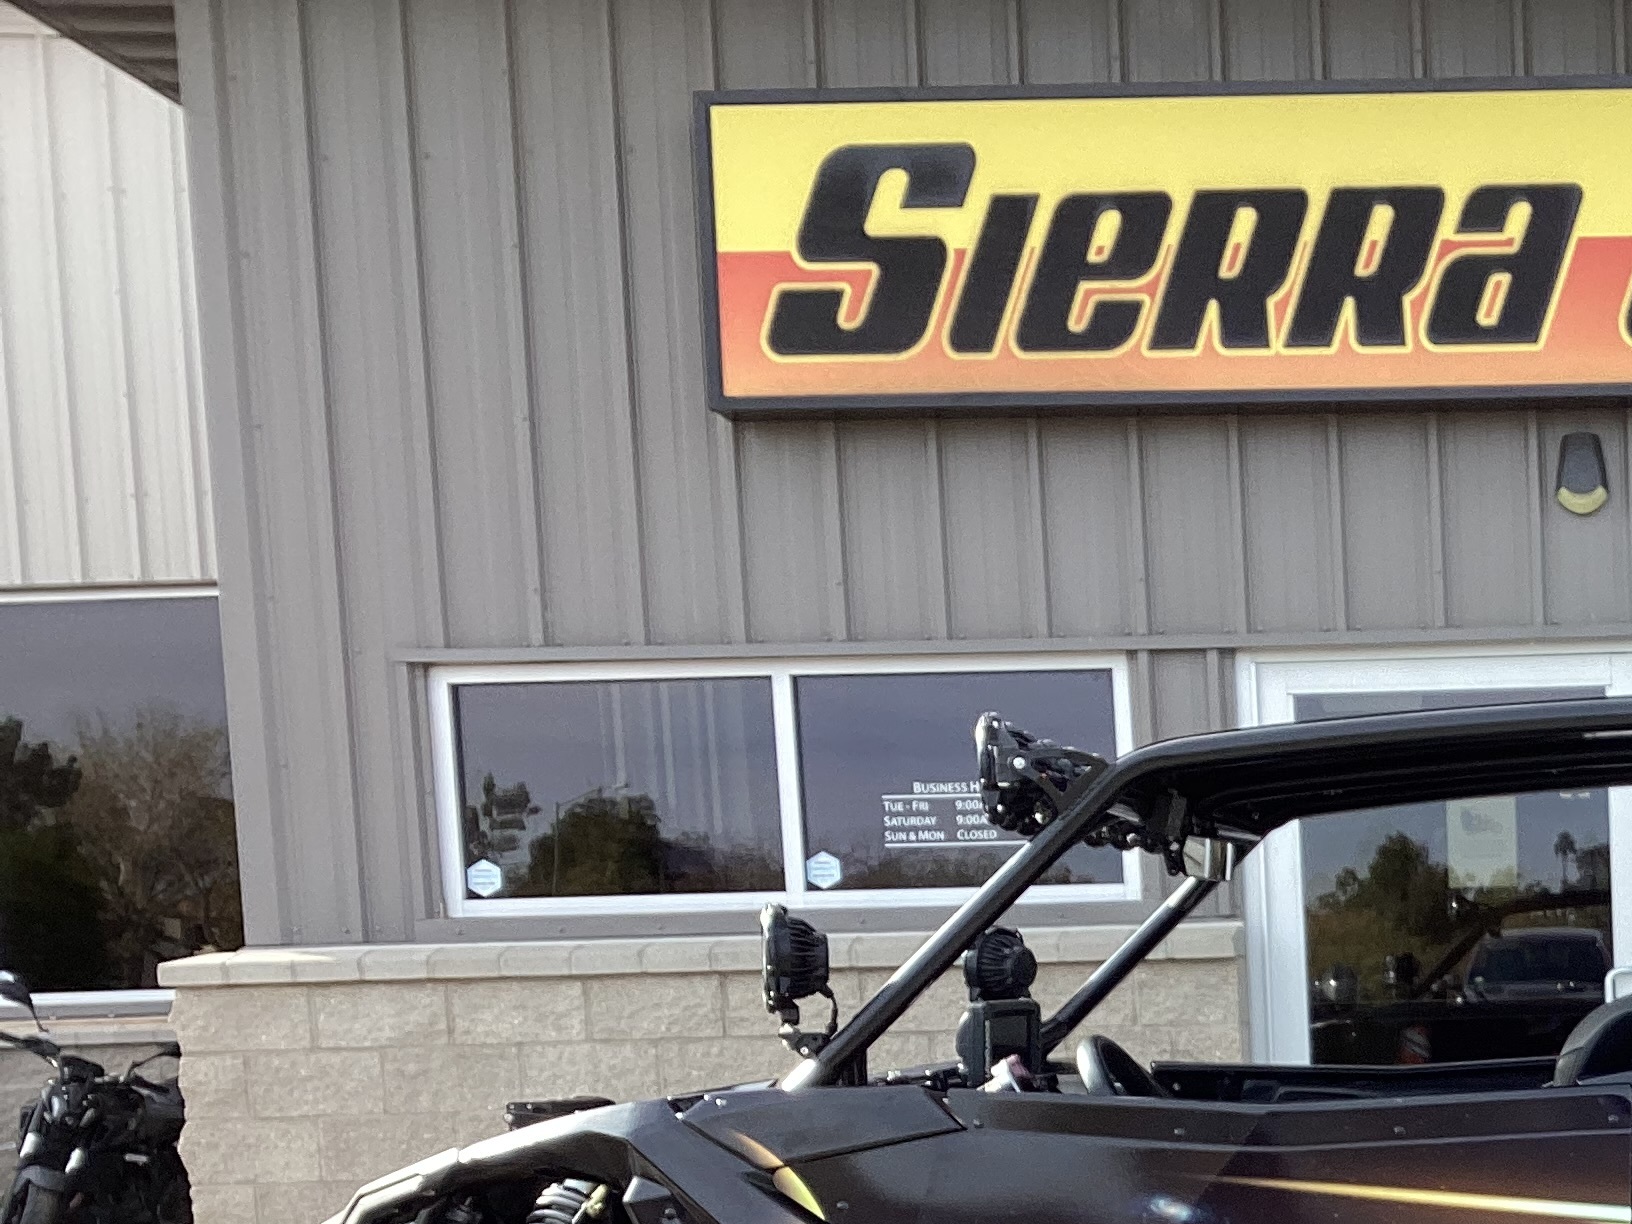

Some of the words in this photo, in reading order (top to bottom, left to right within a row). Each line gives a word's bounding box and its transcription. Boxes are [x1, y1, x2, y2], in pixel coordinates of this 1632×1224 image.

[884, 801, 903, 812] TUE
[955, 800, 982, 811] 9:00
[884, 816, 938, 826] SATURDAY
[884, 831, 907, 842] SUN
[909, 832, 917, 841] &
[918, 830, 946, 841] MON
[957, 829, 998, 840] CLOSED
